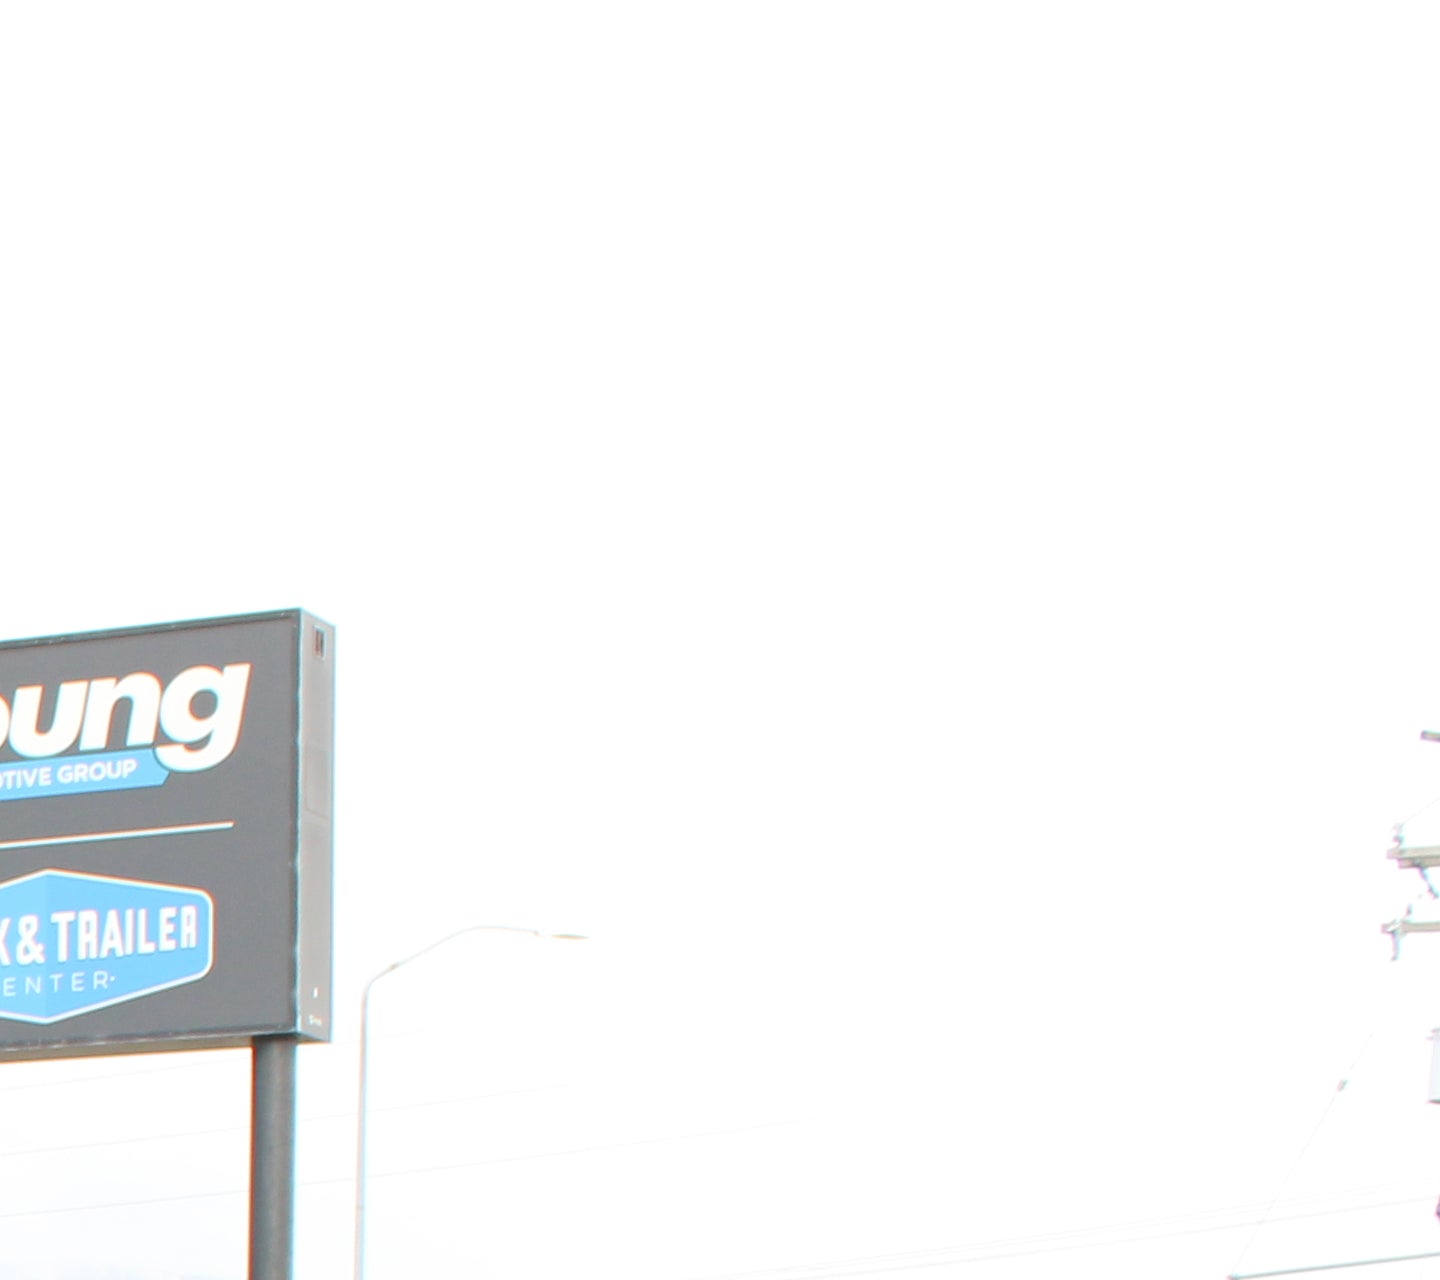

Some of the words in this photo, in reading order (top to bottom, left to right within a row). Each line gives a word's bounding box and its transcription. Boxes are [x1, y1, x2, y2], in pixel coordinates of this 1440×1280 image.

[57, 759, 137, 783] GROUP
[15, 913, 46, 964] &
[51, 904, 197, 963] TRAILER
